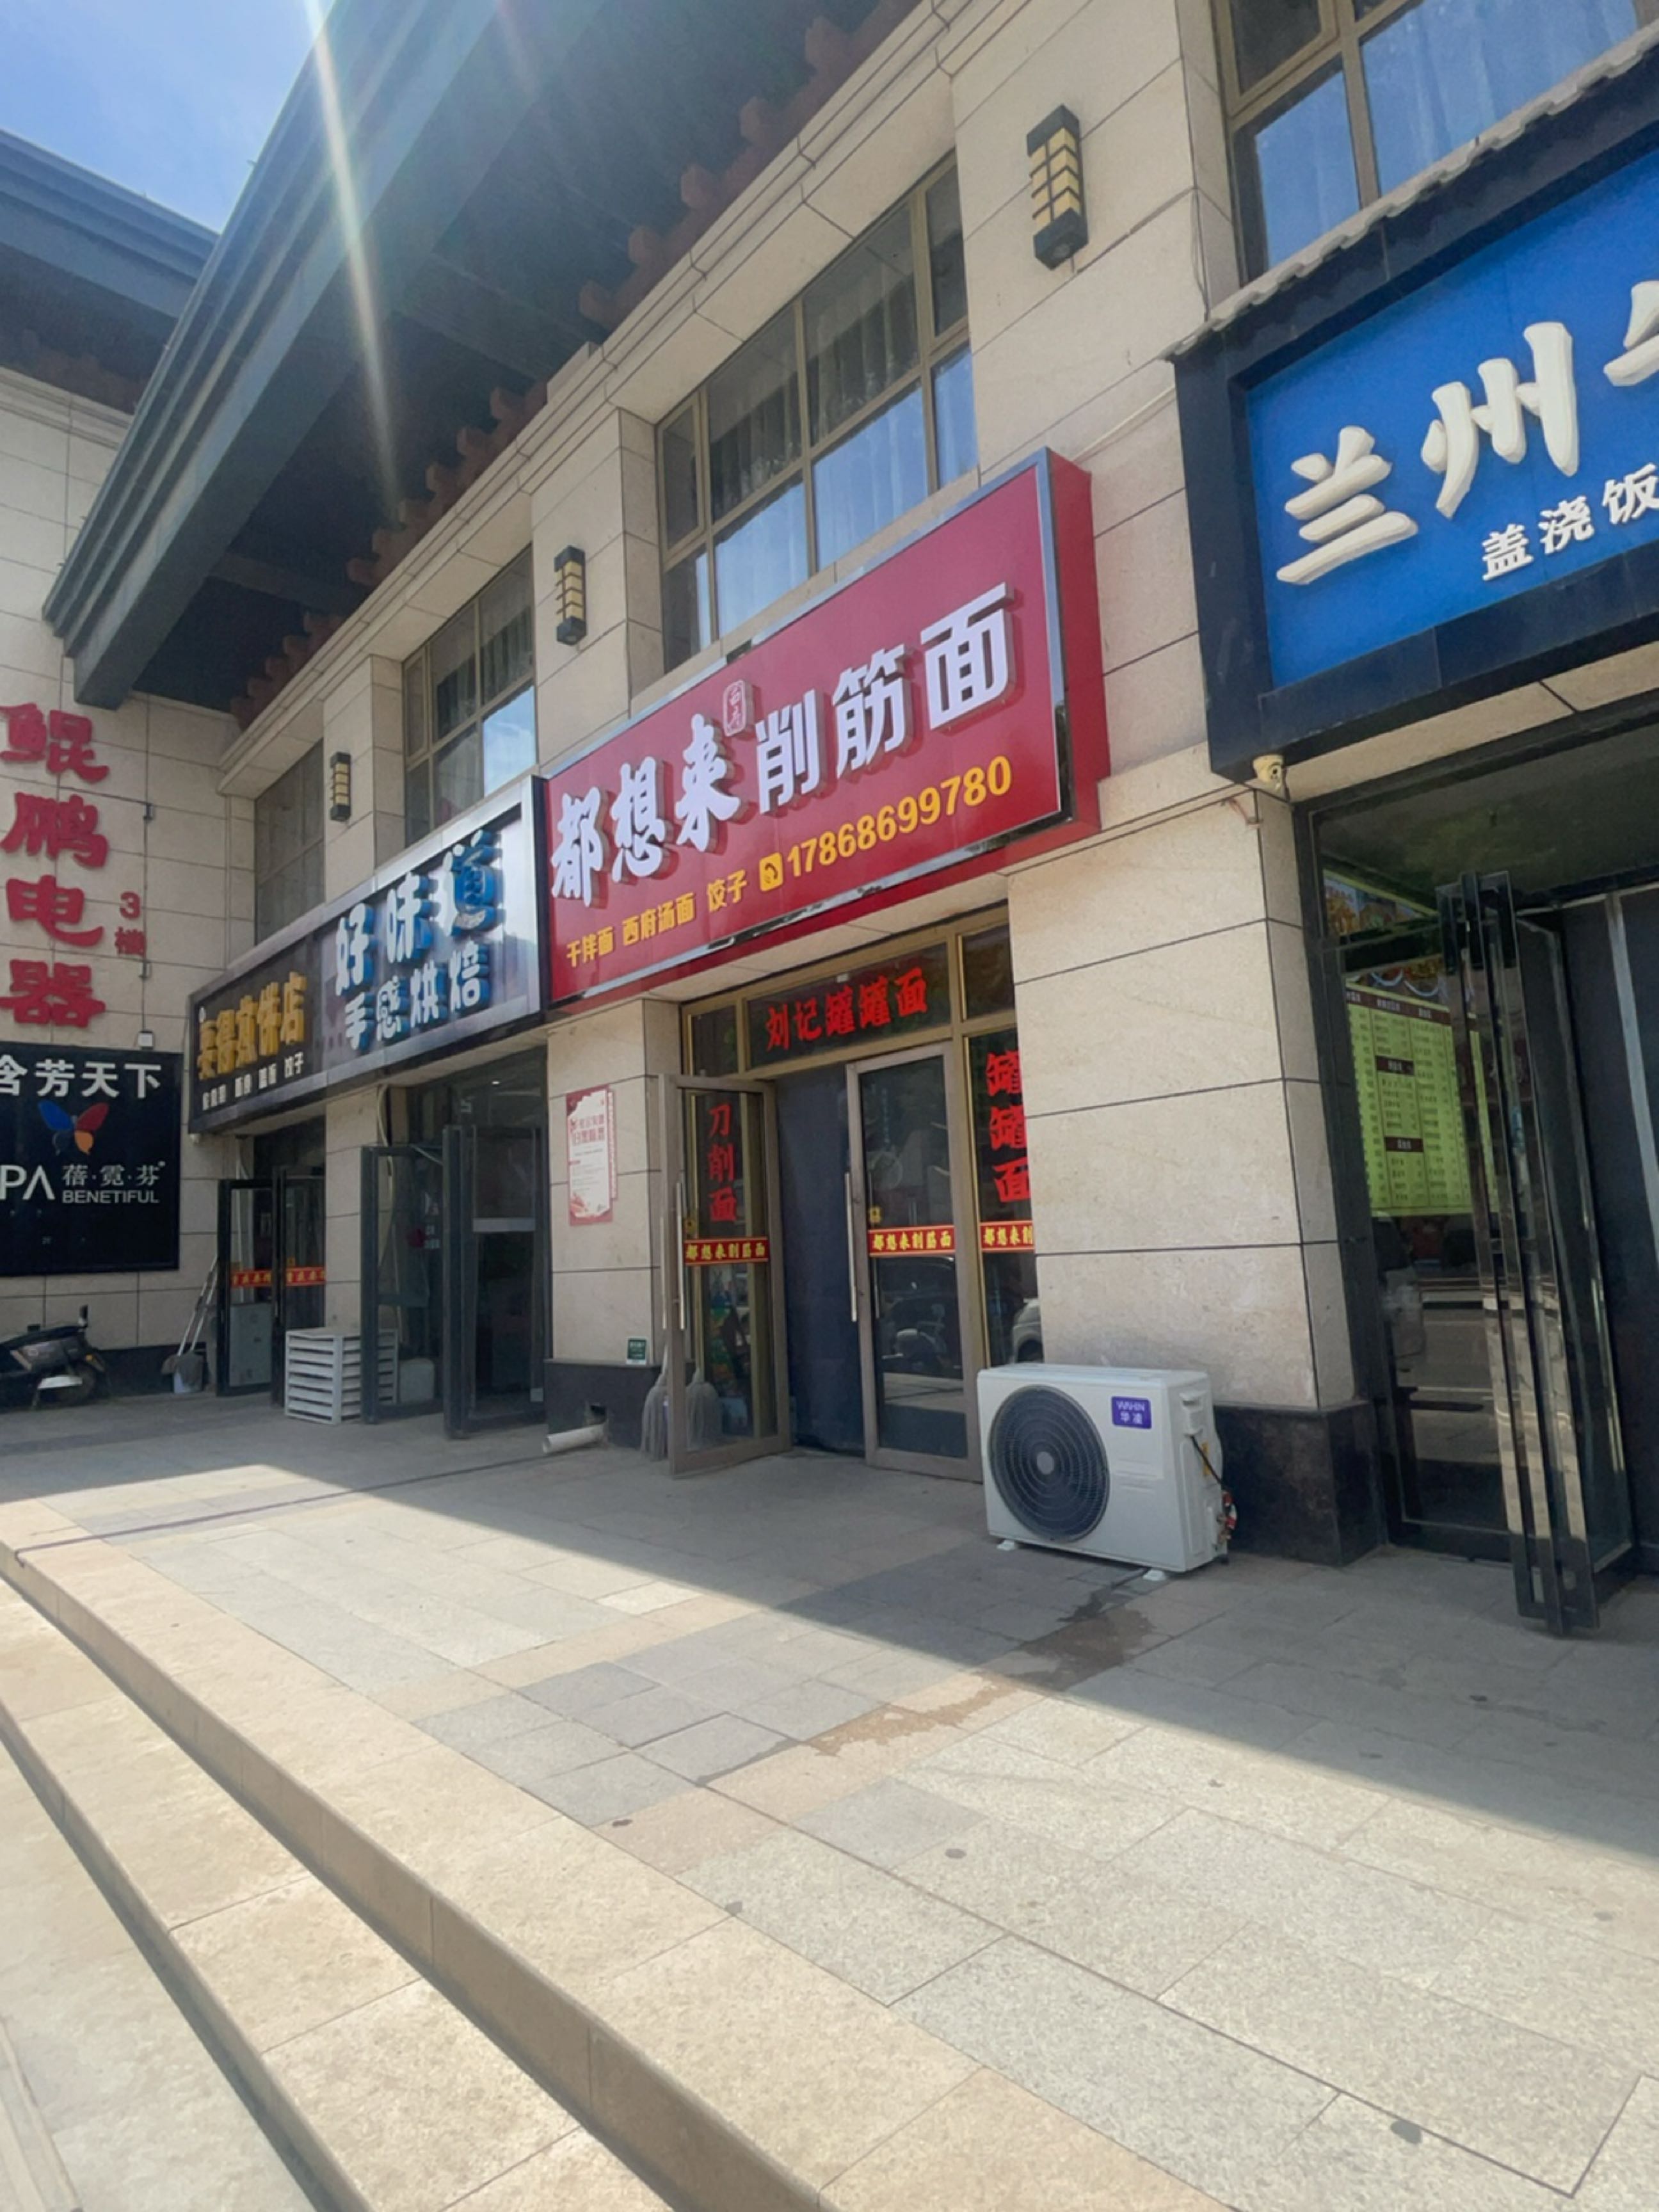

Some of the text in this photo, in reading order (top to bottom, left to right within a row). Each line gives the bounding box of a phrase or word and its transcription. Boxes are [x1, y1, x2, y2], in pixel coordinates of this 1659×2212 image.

[1482, 463, 1659, 581] 盖浇饭
[0, 702, 109, 1028] 鲲鹏电器
[707, 870, 748, 913] 饺子
[787, 755, 1012, 877] 17868699780
[335, 828, 497, 996] 好味道
[345, 940, 490, 1050] 手感烘焙
[766, 967, 928, 1045] 刘记罐罐面
[62, 1190, 159, 1203] BENETIFUL
[709, 1103, 737, 1221] 刀削面
